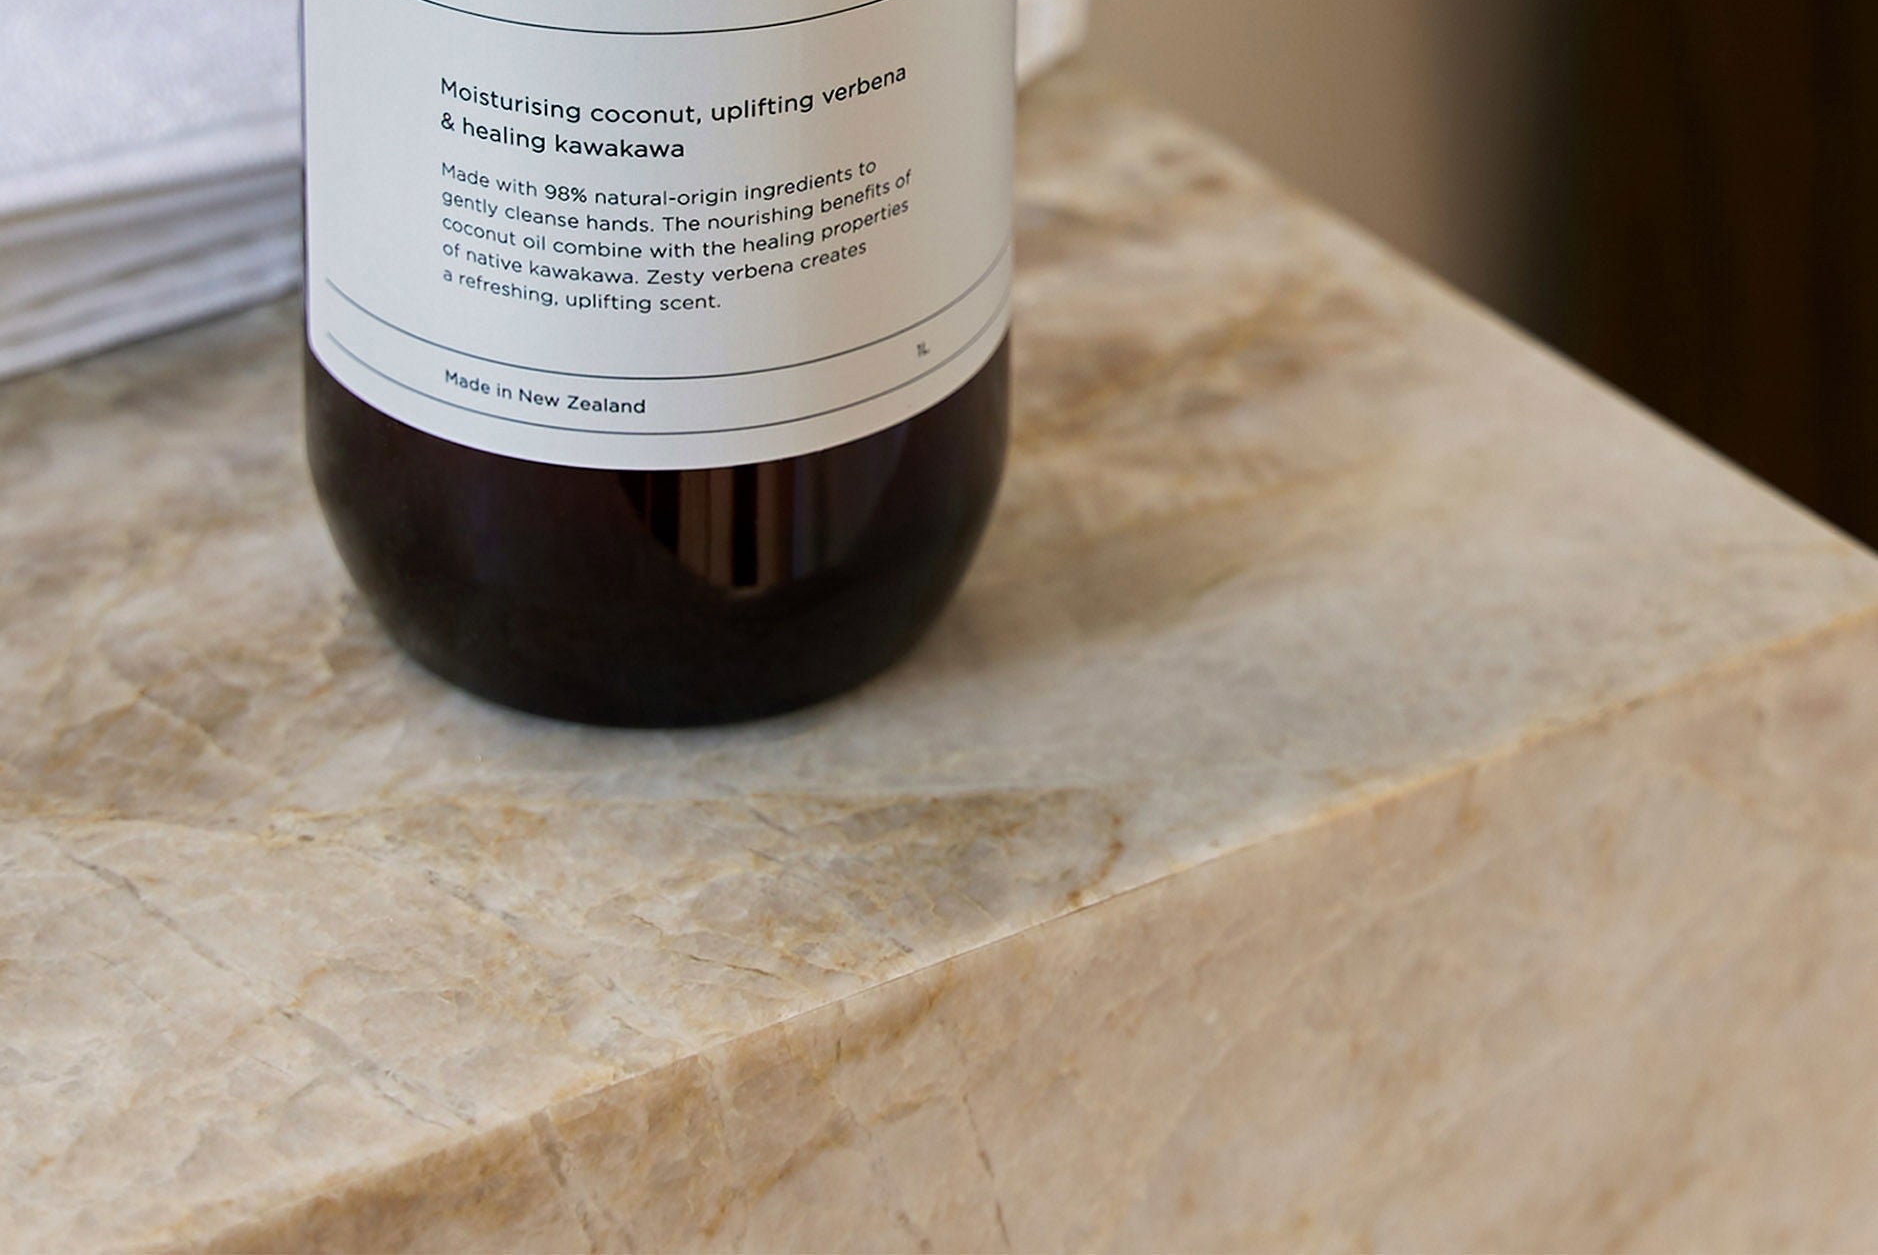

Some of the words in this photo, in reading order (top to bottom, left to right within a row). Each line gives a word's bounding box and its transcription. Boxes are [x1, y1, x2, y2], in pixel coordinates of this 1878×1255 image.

[441, 77, 581, 124] Moisturising
[590, 105, 702, 126] coconut,
[711, 94, 814, 124] uplifting
[821, 66, 906, 105] verbena
[440, 111, 456, 132] &
[462, 116, 546, 154] healing
[555, 133, 685, 159] kawakawa
[441, 161, 490, 189] Made
[495, 178, 538, 197] with
[544, 183, 588, 204] 98%
[594, 187, 738, 207] natural-origin
[744, 168, 853, 201] ingredients
[858, 161, 877, 177] to
[441, 191, 499, 218] gently
[504, 205, 580, 229] cleanse
[586, 214, 655, 233] hands.
[661, 215, 701, 233] The
[707, 204, 814, 231] nourishing
[820, 181, 891, 214] benefits
[894, 168, 912, 189] of
[442, 217, 517, 247] coconut
[522, 234, 546, 251] oil
[552, 240, 643, 259] combine
[649, 242, 695, 259] with
[702, 240, 737, 258] the
[742, 230, 815, 253] healing
[821, 200, 909, 242] properties
[442, 242, 460, 258] of
[466, 250, 523, 274] native
[529, 259, 639, 285] kawakawa.
[646, 269, 705, 287] Zesty
[711, 260, 794, 282] verbena
[800, 241, 867, 270] creates
[443, 269, 453, 282] a
[565, 292, 652, 314] uplifting
[659, 294, 721, 311] scent.
[445, 369, 491, 395] Made
[496, 383, 513, 400] in
[518, 388, 560, 408] New
[567, 394, 646, 415] Zealand
